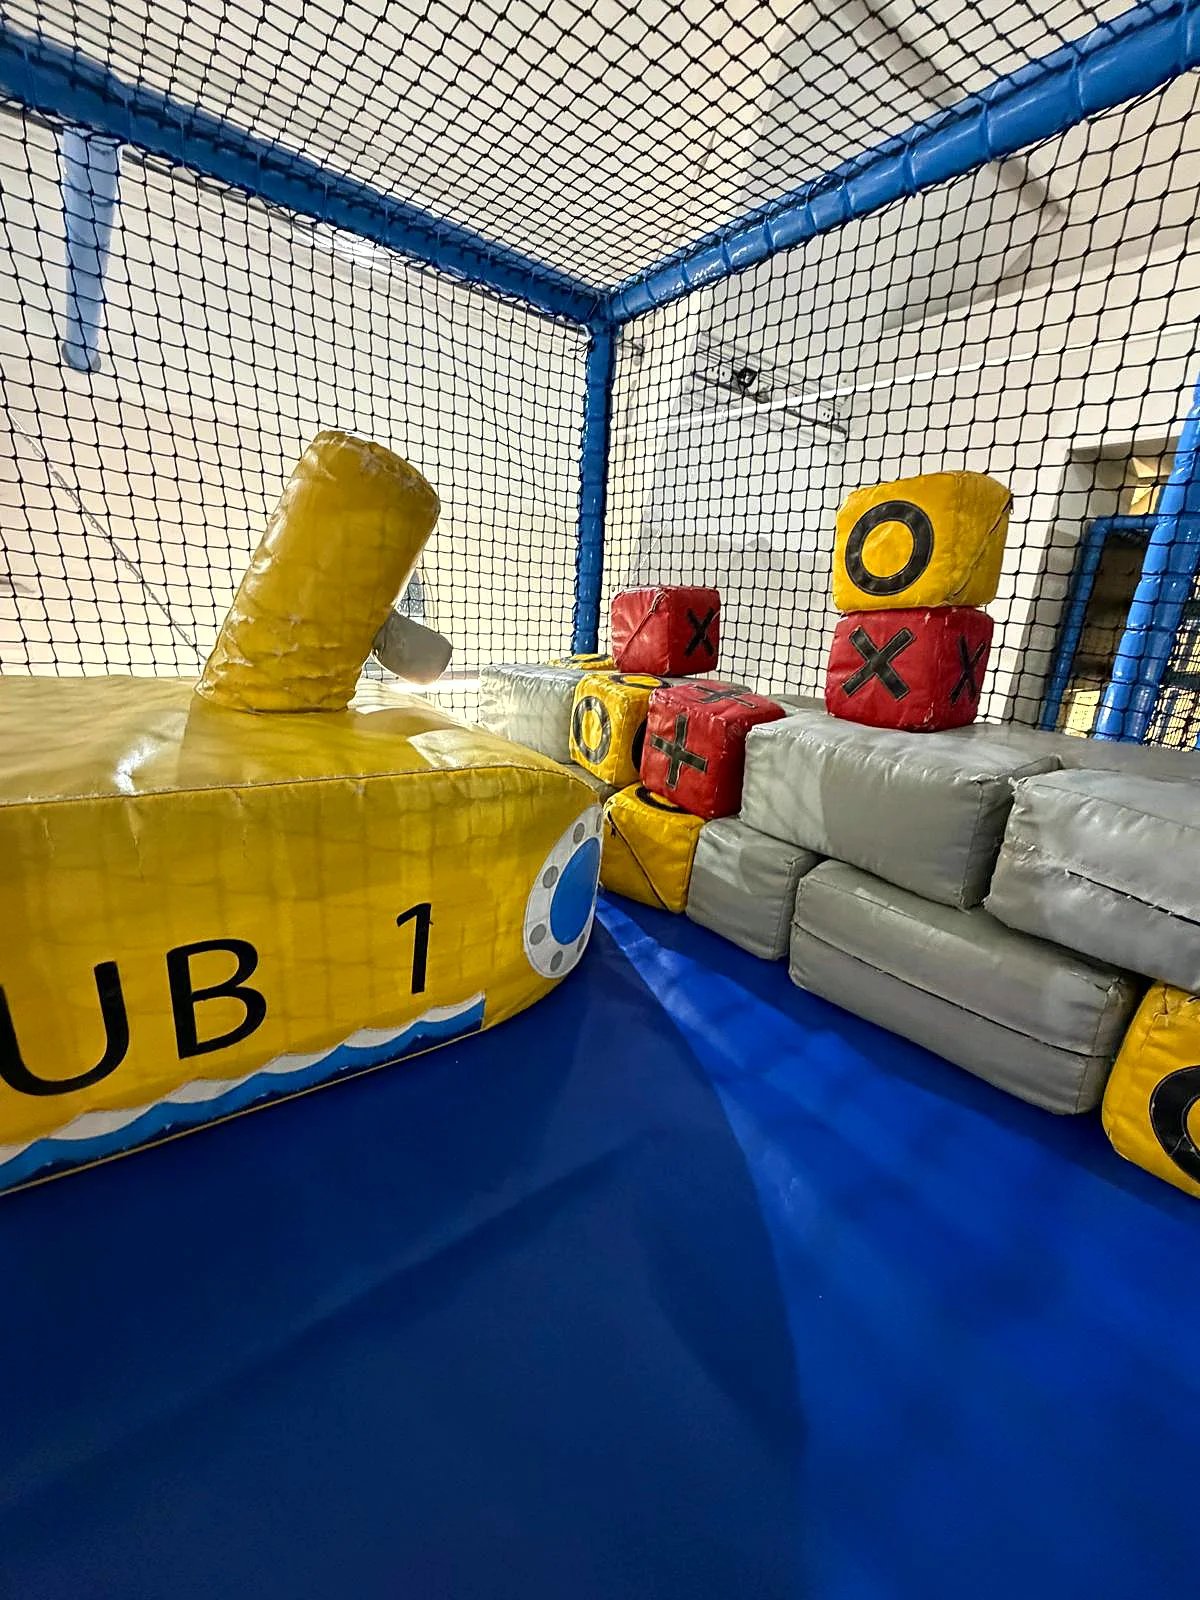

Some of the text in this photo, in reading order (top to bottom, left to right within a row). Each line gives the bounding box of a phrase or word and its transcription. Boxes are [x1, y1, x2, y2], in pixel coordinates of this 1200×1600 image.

[845, 500, 935, 597] O
[842, 625, 915, 701] X
[396, 902, 432, 995] 1
